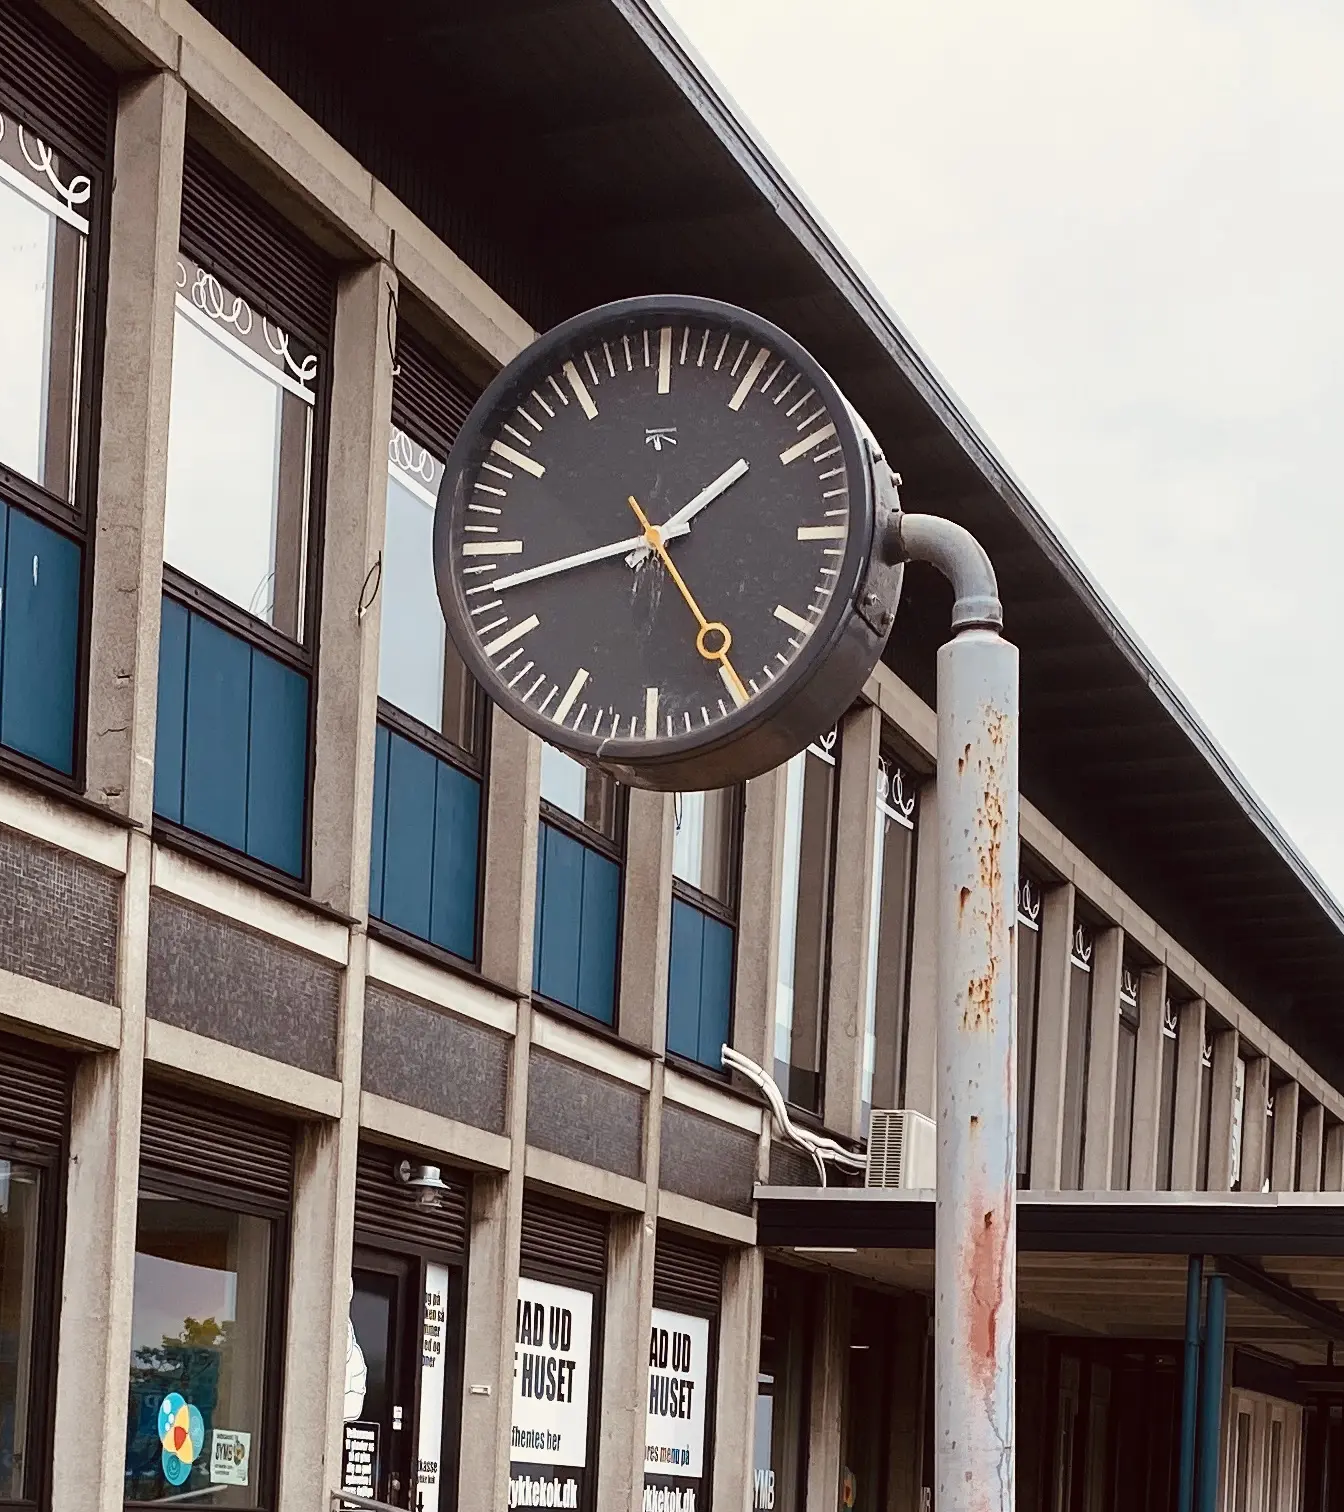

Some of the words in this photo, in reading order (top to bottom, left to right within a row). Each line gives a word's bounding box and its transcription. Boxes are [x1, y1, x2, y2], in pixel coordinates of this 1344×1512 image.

[549, 1305, 572, 1352] UD
[672, 1331, 692, 1373] UD
[521, 1353, 576, 1403] HUSET
[649, 1375, 695, 1420] HUSET
[547, 1429, 561, 1452] her
[681, 1443, 690, 1467] på
